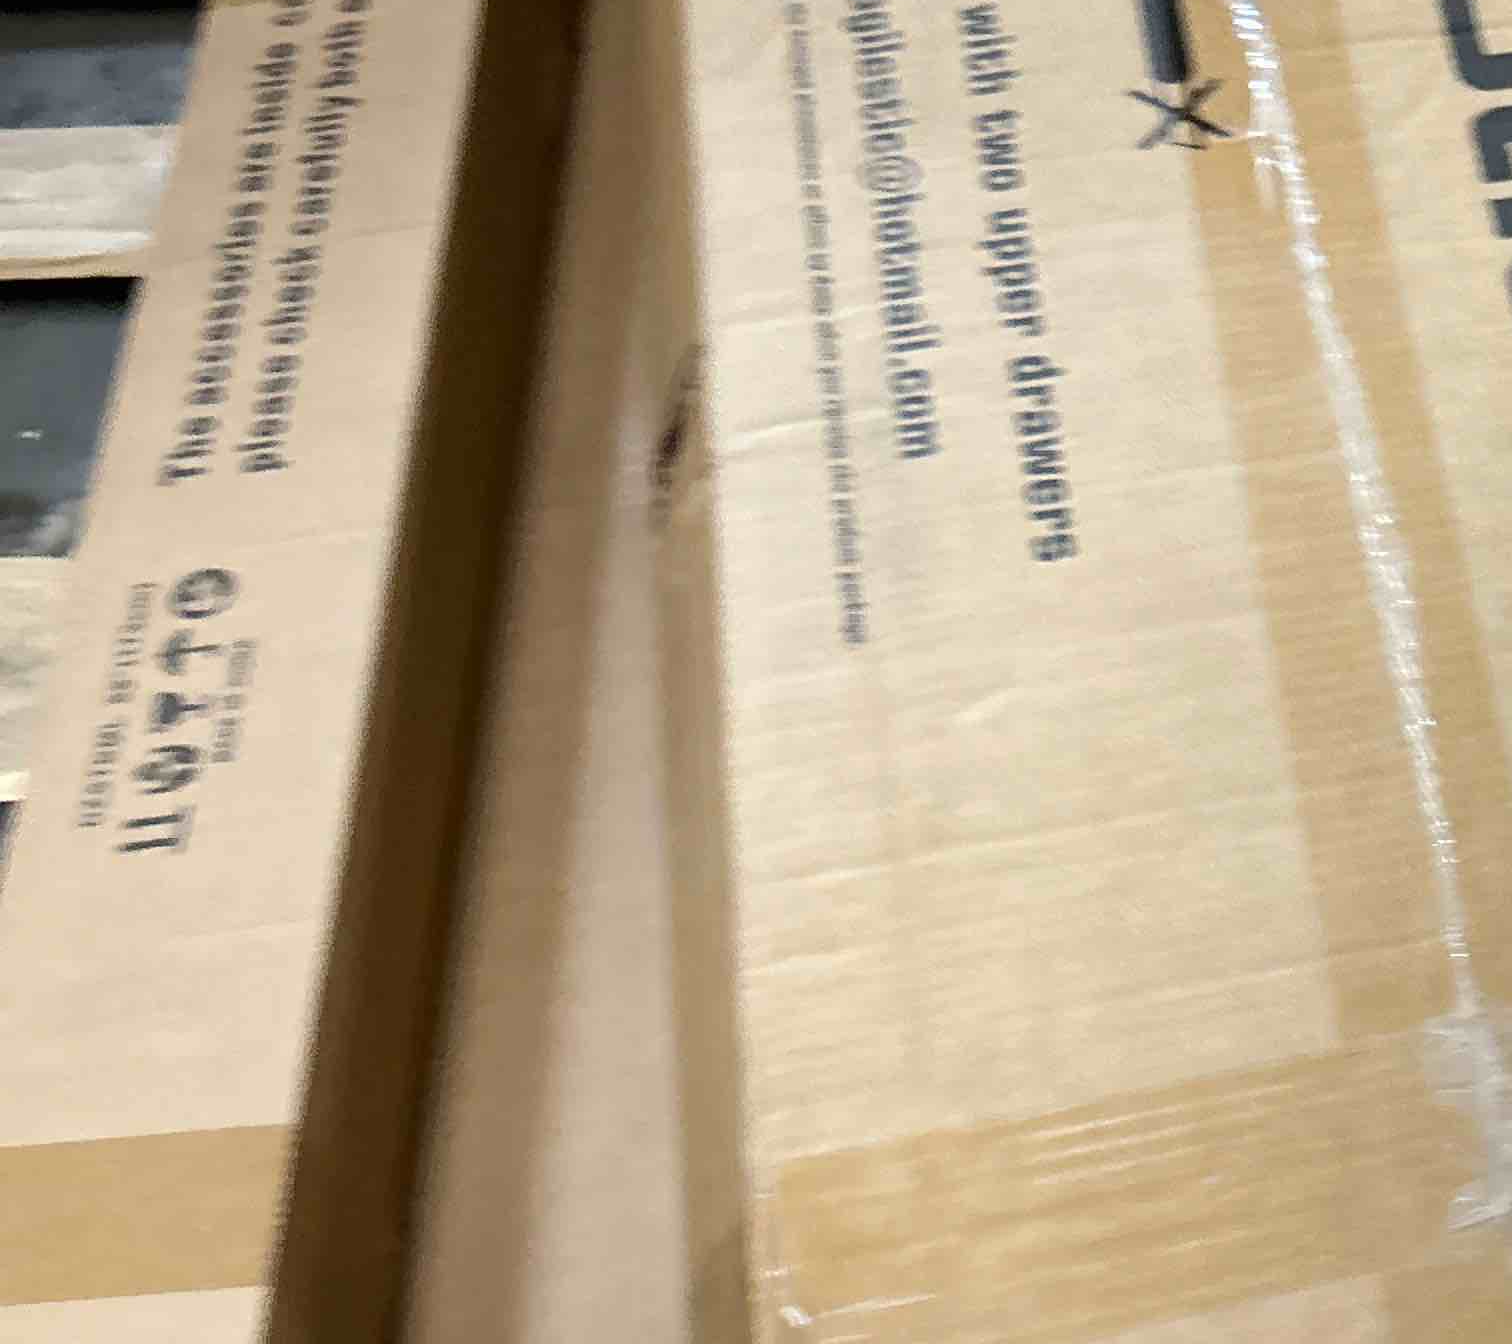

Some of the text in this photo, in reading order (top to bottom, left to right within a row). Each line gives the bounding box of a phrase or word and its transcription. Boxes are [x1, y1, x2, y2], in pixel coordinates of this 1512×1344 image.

[956, 4, 1021, 96] with
[972, 110, 1025, 192] two
[973, 207, 1047, 337] upper
[1005, 355, 1081, 562] drawers
